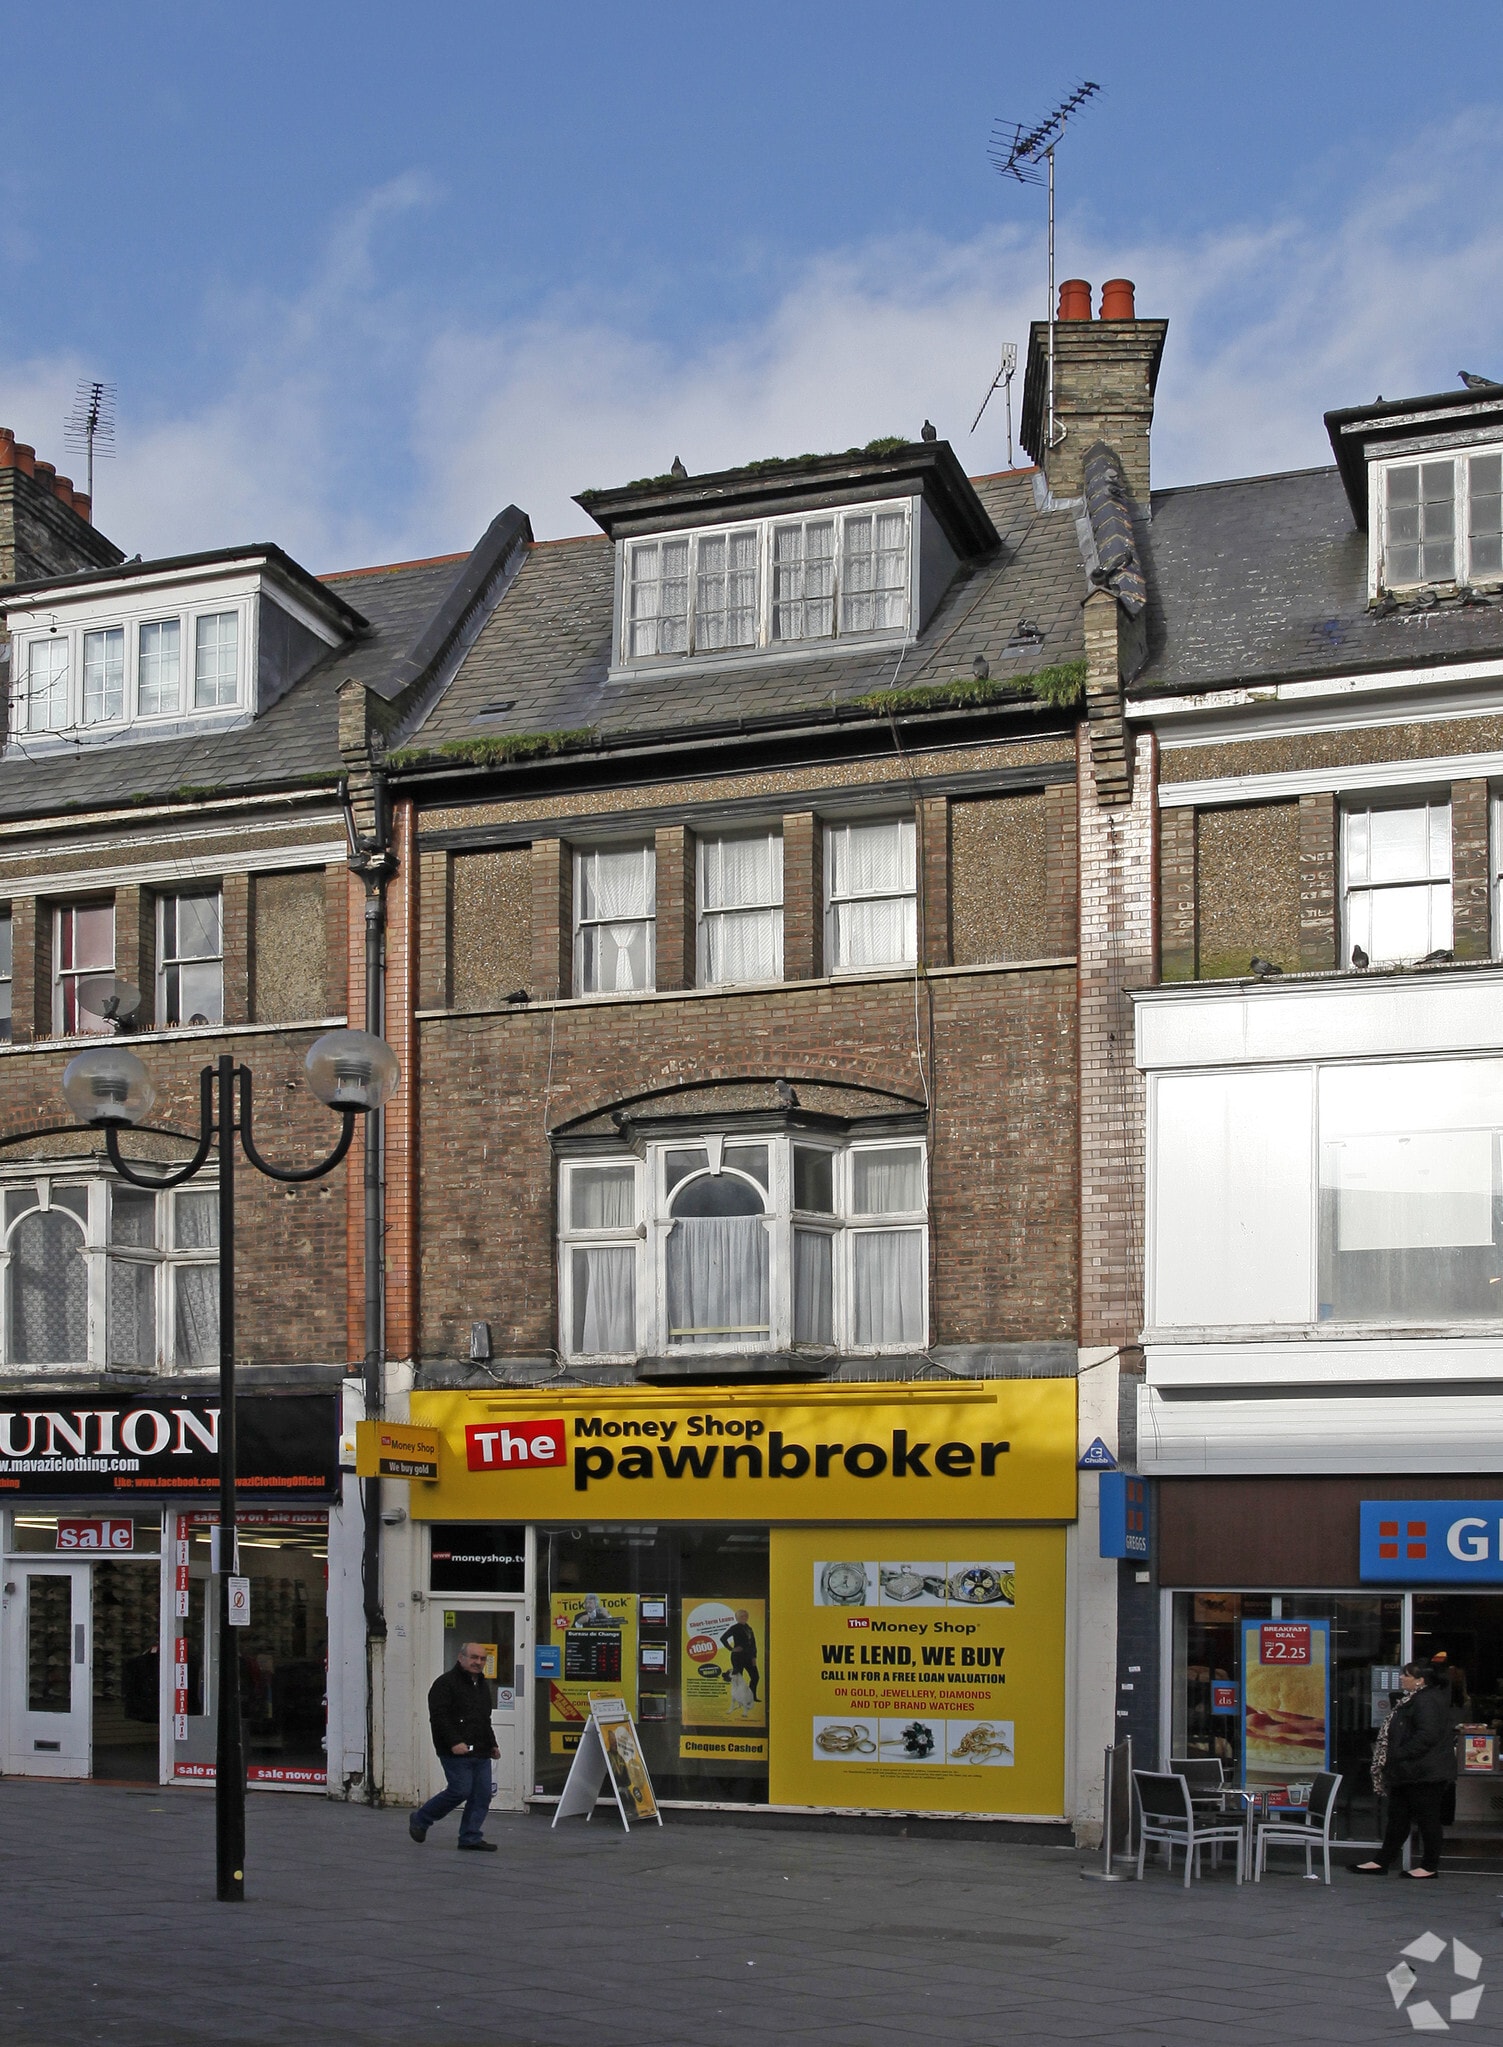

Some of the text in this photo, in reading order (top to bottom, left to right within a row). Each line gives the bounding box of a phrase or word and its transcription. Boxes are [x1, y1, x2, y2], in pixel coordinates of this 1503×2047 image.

[0, 1409, 220, 1457] UNION
[474, 1415, 764, 1462] The Money Shop
[392, 1440, 416, 1453] Money
[417, 1442, 435, 1455] Shop
[574, 1429, 1010, 1491] pawnbroker
[389, 1462, 430, 1476] We buy gold
[194, 1512, 219, 1522] sale
[248, 1514, 263, 1522] on
[269, 1514, 291, 1522] ale
[292, 1514, 317, 1522] now
[60, 1521, 131, 1549] sale
[1447, 1517, 1503, 1562] G
[1125, 1534, 1147, 1552] GREGGS
[451, 1554, 525, 1564] moneyshop.tv
[849, 1619, 976, 1636] The Money Shop
[822, 1644, 1006, 1668] WE LEND, WE BUY
[1265, 1642, 1306, 1659] £2.25
[821, 1671, 1006, 1684] CALL IN FOR A FREE LOAN VALUATION
[835, 1688, 992, 1700] ON GOLD, JEWELLERY, DIAMONDS
[850, 1700, 975, 1711] AND TOP BRAND WATCHES
[685, 1741, 763, 1753] Cheques Cashed
[179, 1765, 204, 1775] sale
[258, 1769, 283, 1779] sale
[285, 1771, 312, 1780] now
